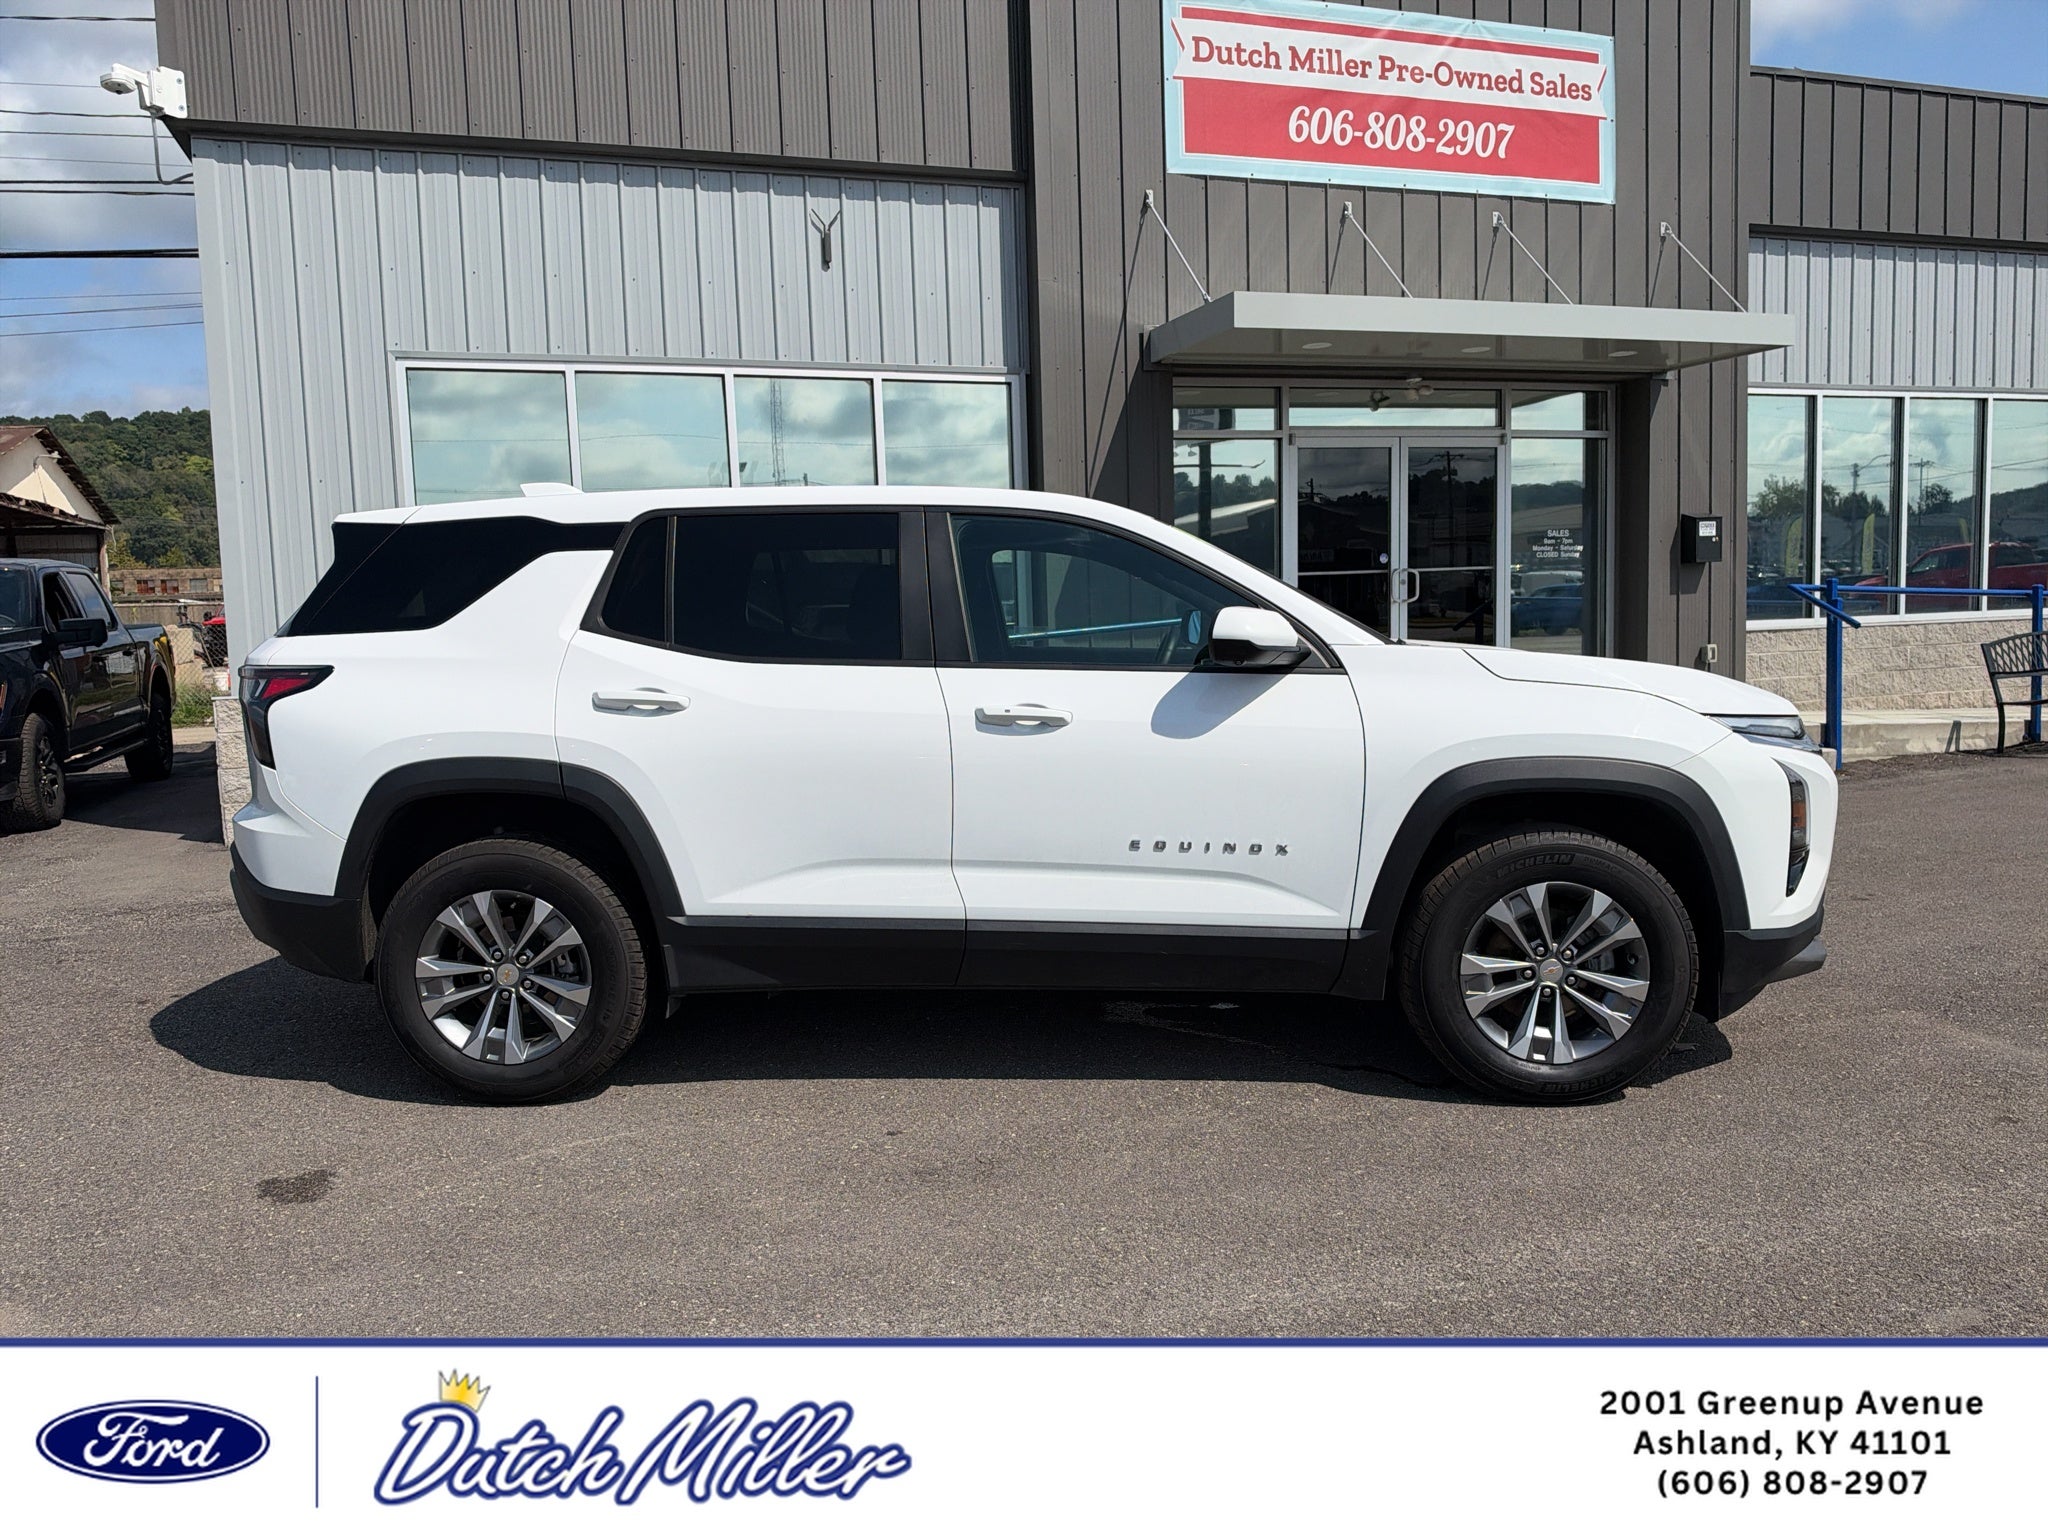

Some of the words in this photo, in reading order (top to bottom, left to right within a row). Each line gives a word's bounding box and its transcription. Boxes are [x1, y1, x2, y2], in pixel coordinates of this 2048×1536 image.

[1191, 36, 1282, 70] Dutch
[1288, 45, 1373, 79] Miller
[1378, 55, 1525, 94] Pre-Owned
[1530, 71, 1593, 101] Sales
[1288, 105, 1516, 159] 606-808-2907
[1547, 529, 1569, 537] SALES
[1128, 839, 1288, 856] EQUINOX
[1496, 854, 1572, 877] MICHELIN
